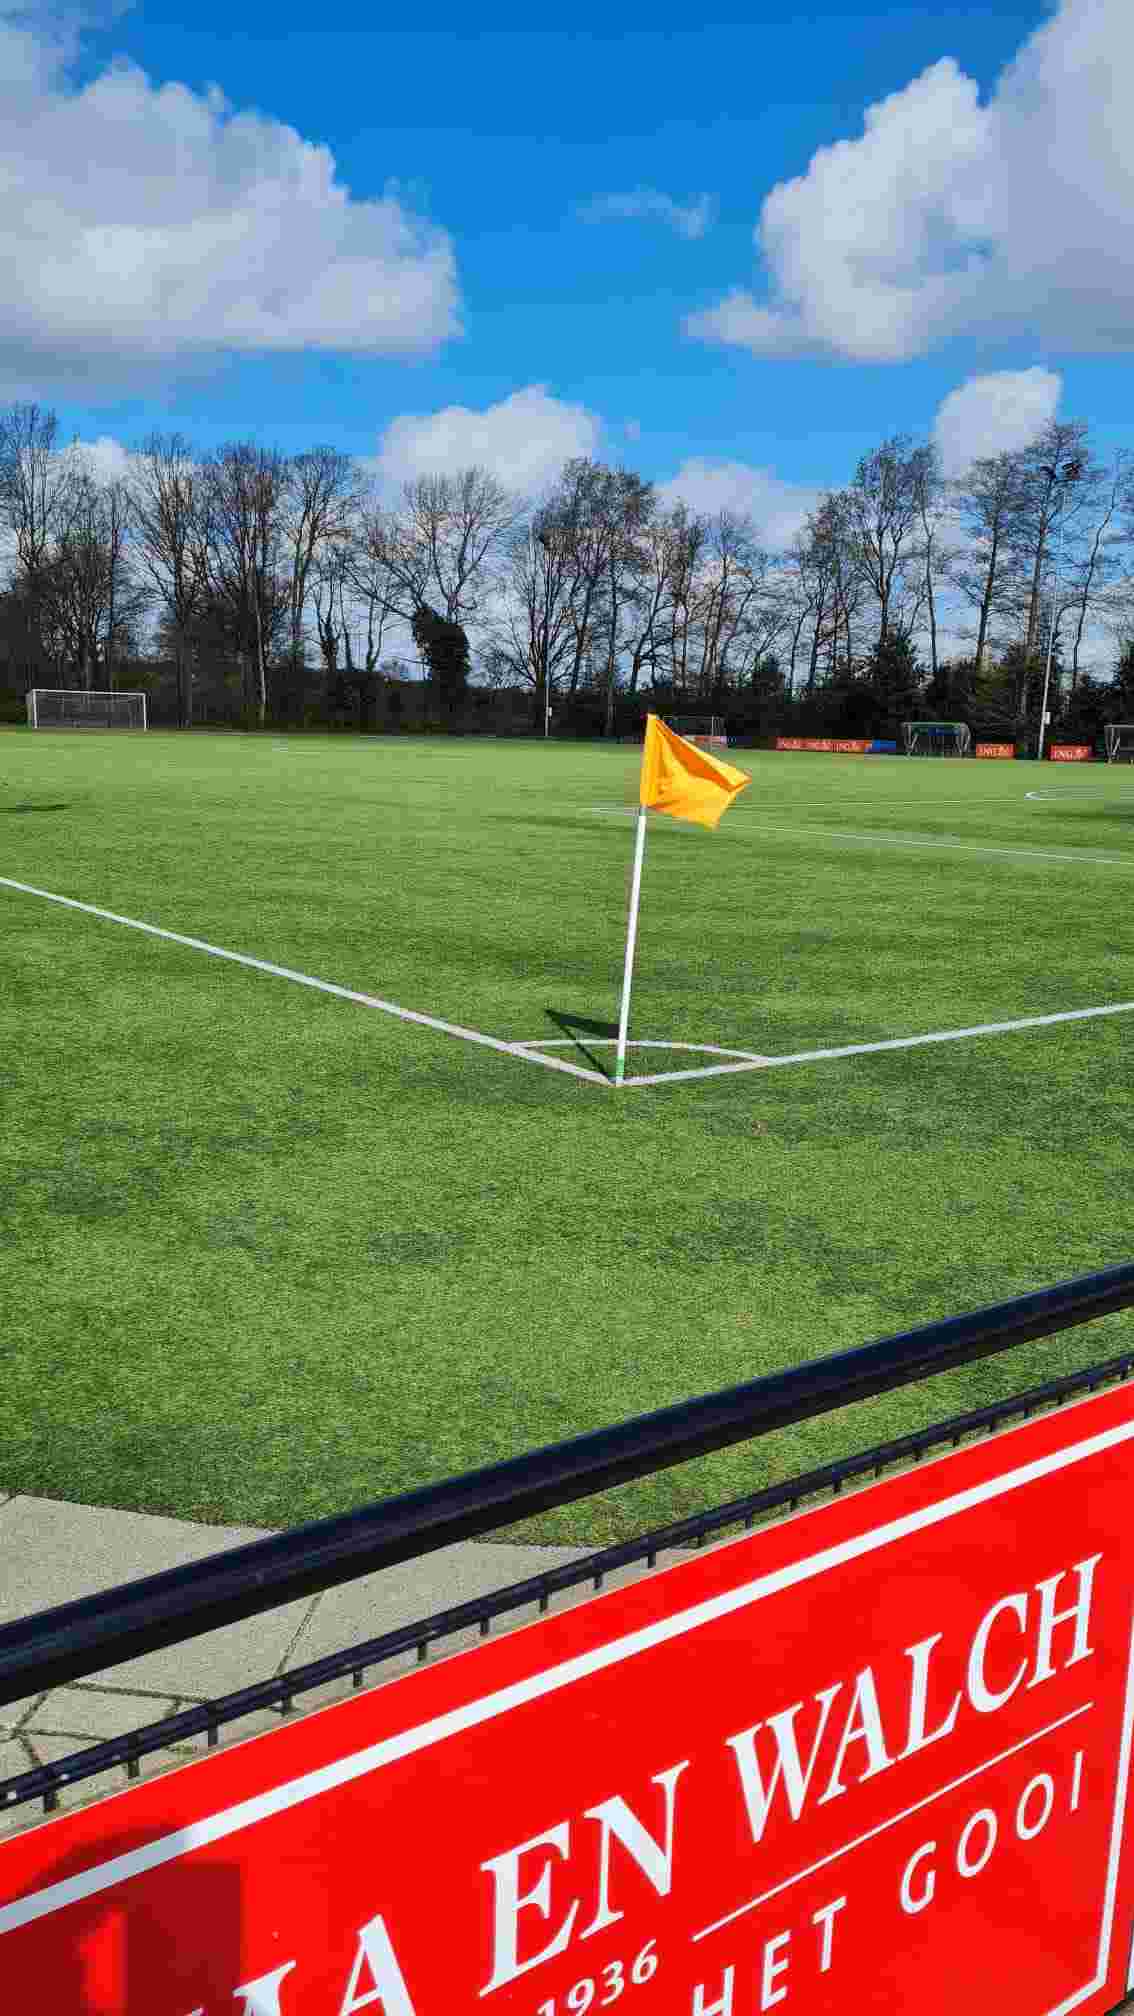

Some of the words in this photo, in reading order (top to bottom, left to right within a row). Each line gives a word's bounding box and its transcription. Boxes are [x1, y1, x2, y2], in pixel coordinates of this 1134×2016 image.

[479, 1759, 690, 1998] EN
[725, 1553, 1103, 1843] WALCH
[692, 1895, 847, 2016] HET
[899, 1750, 1083, 1914] GOOI
